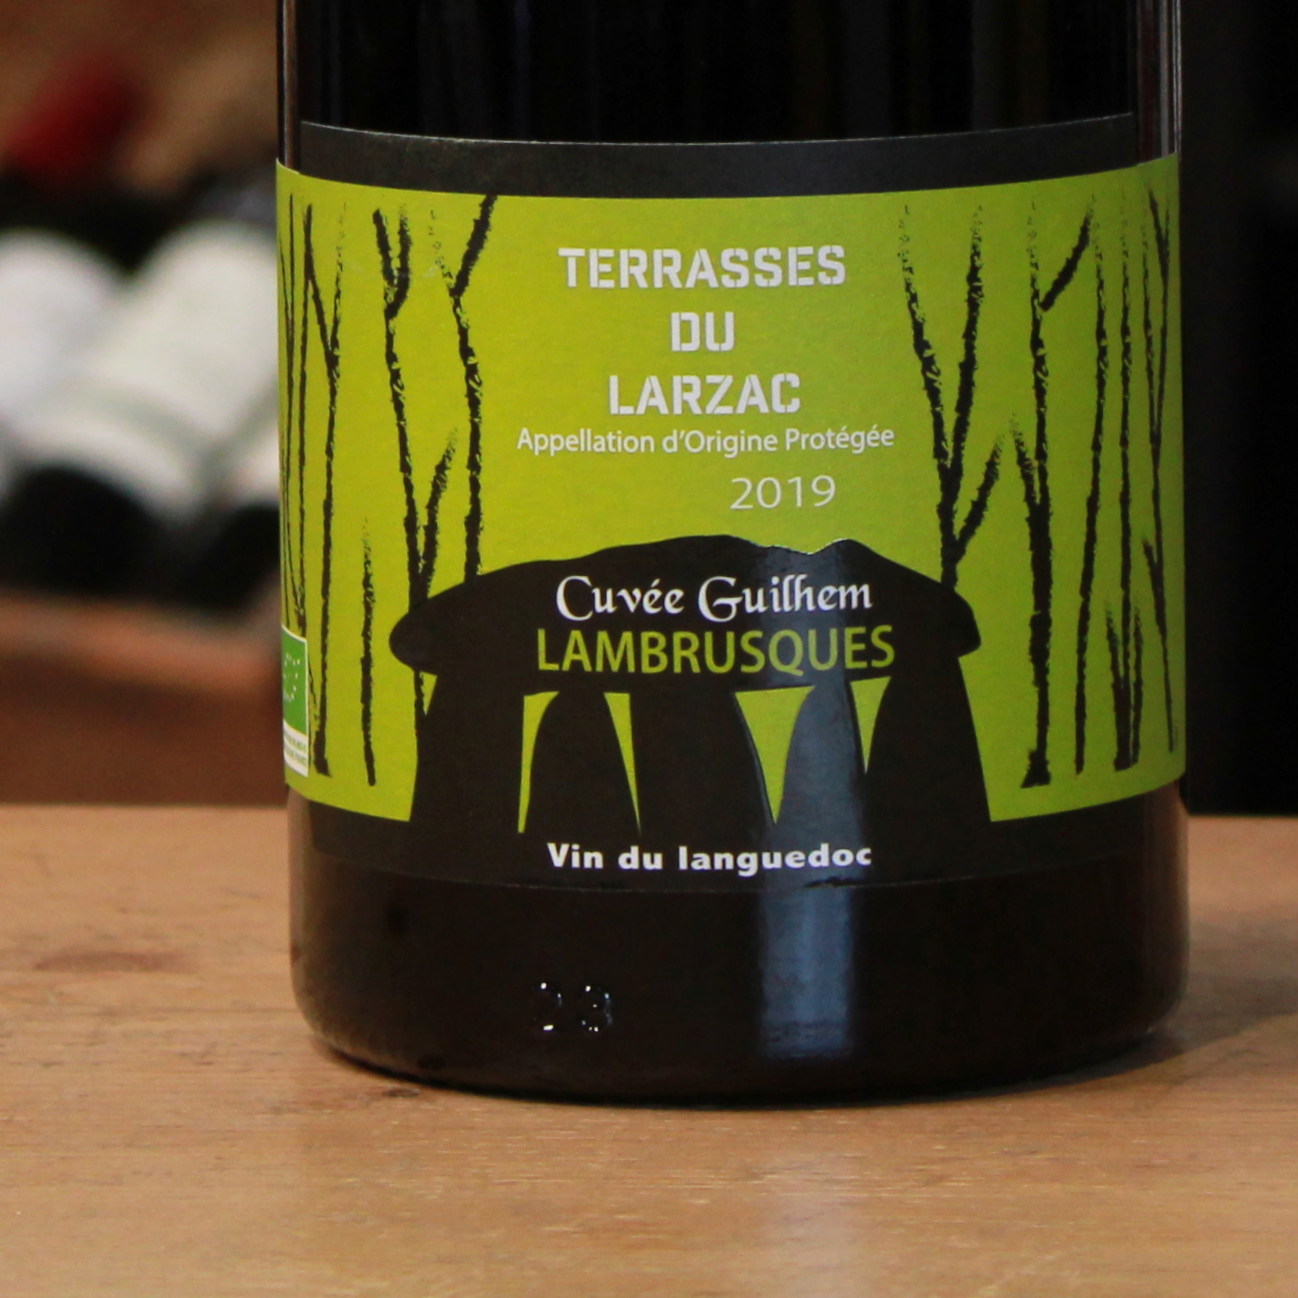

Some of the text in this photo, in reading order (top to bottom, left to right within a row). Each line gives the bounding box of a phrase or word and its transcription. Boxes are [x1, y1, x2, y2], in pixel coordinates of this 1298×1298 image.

[557, 245, 847, 289] TERRASSES
[669, 311, 736, 352] DU
[608, 372, 802, 416] LARZAC
[516, 427, 655, 457] Appellation
[785, 424, 895, 455] Protégée
[729, 474, 837, 510] 2019
[556, 573, 873, 622] Cuvée Guilhem
[536, 624, 896, 677] LAMBRUSQUES
[547, 842, 872, 877] Vin du languedoc
